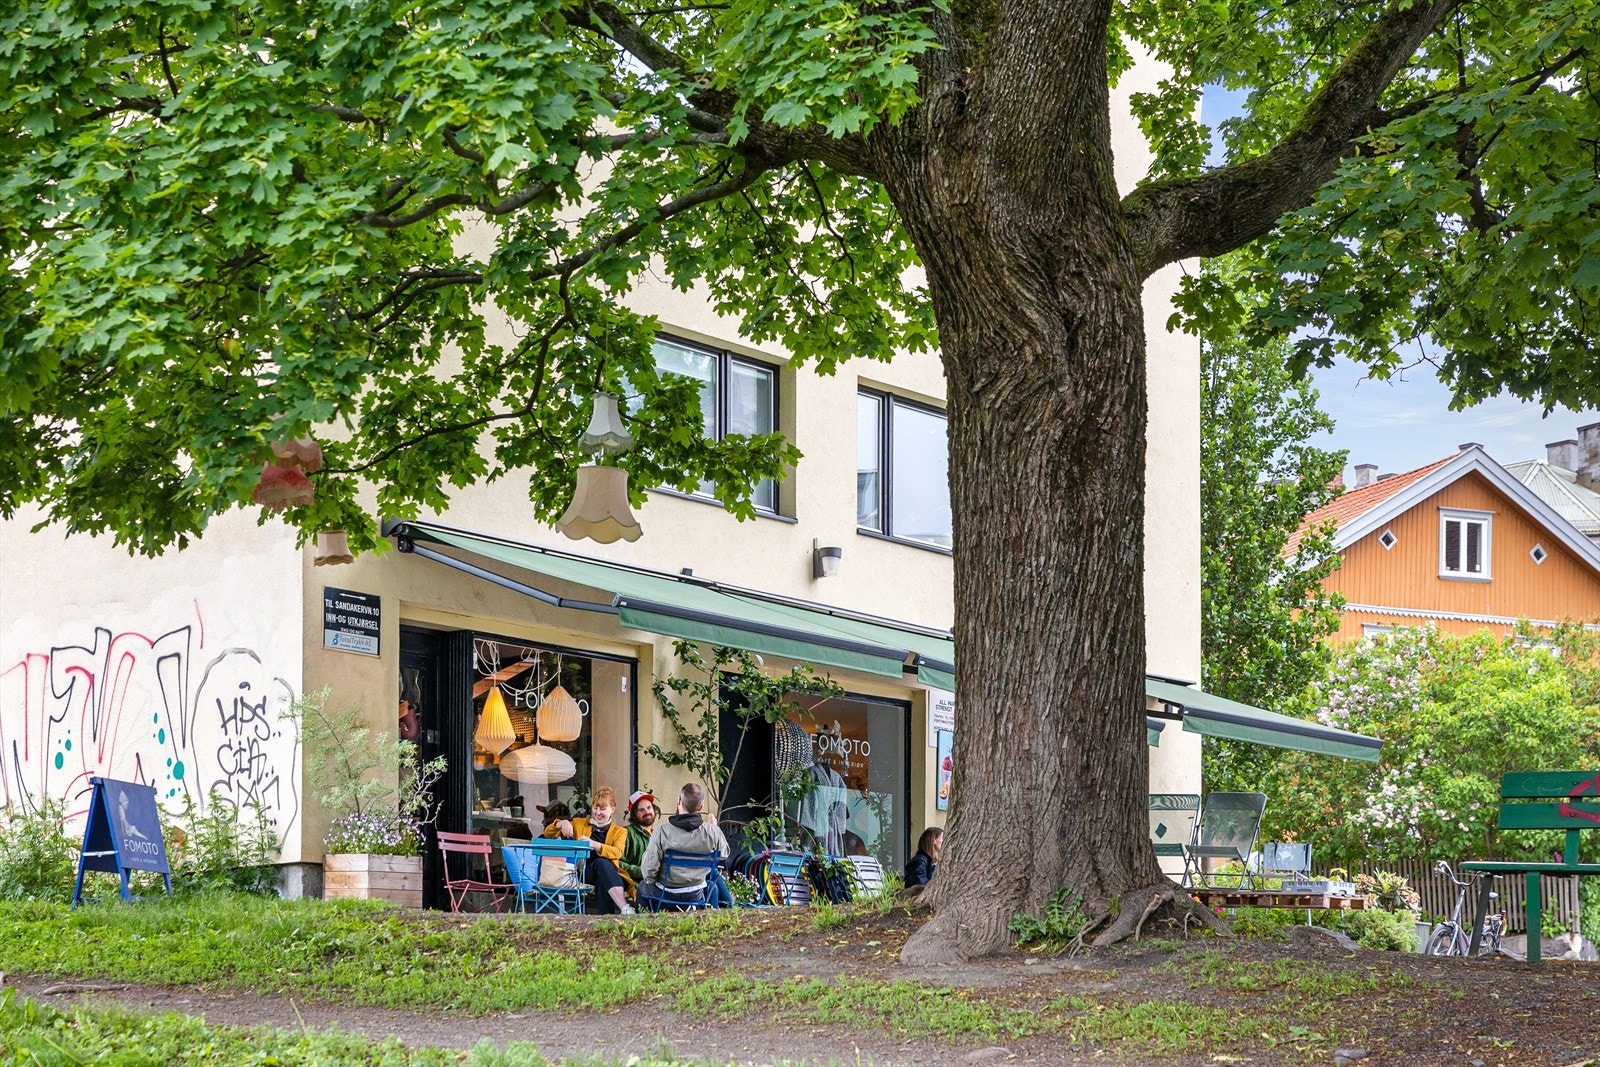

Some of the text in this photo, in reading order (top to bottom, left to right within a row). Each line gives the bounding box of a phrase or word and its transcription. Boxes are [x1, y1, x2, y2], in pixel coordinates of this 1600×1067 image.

[325, 598, 334, 608] TIL
[347, 616, 379, 631] UTKJØRSEL
[810, 733, 871, 757] FOMOTO
[123, 839, 159, 856] FOMOTO
